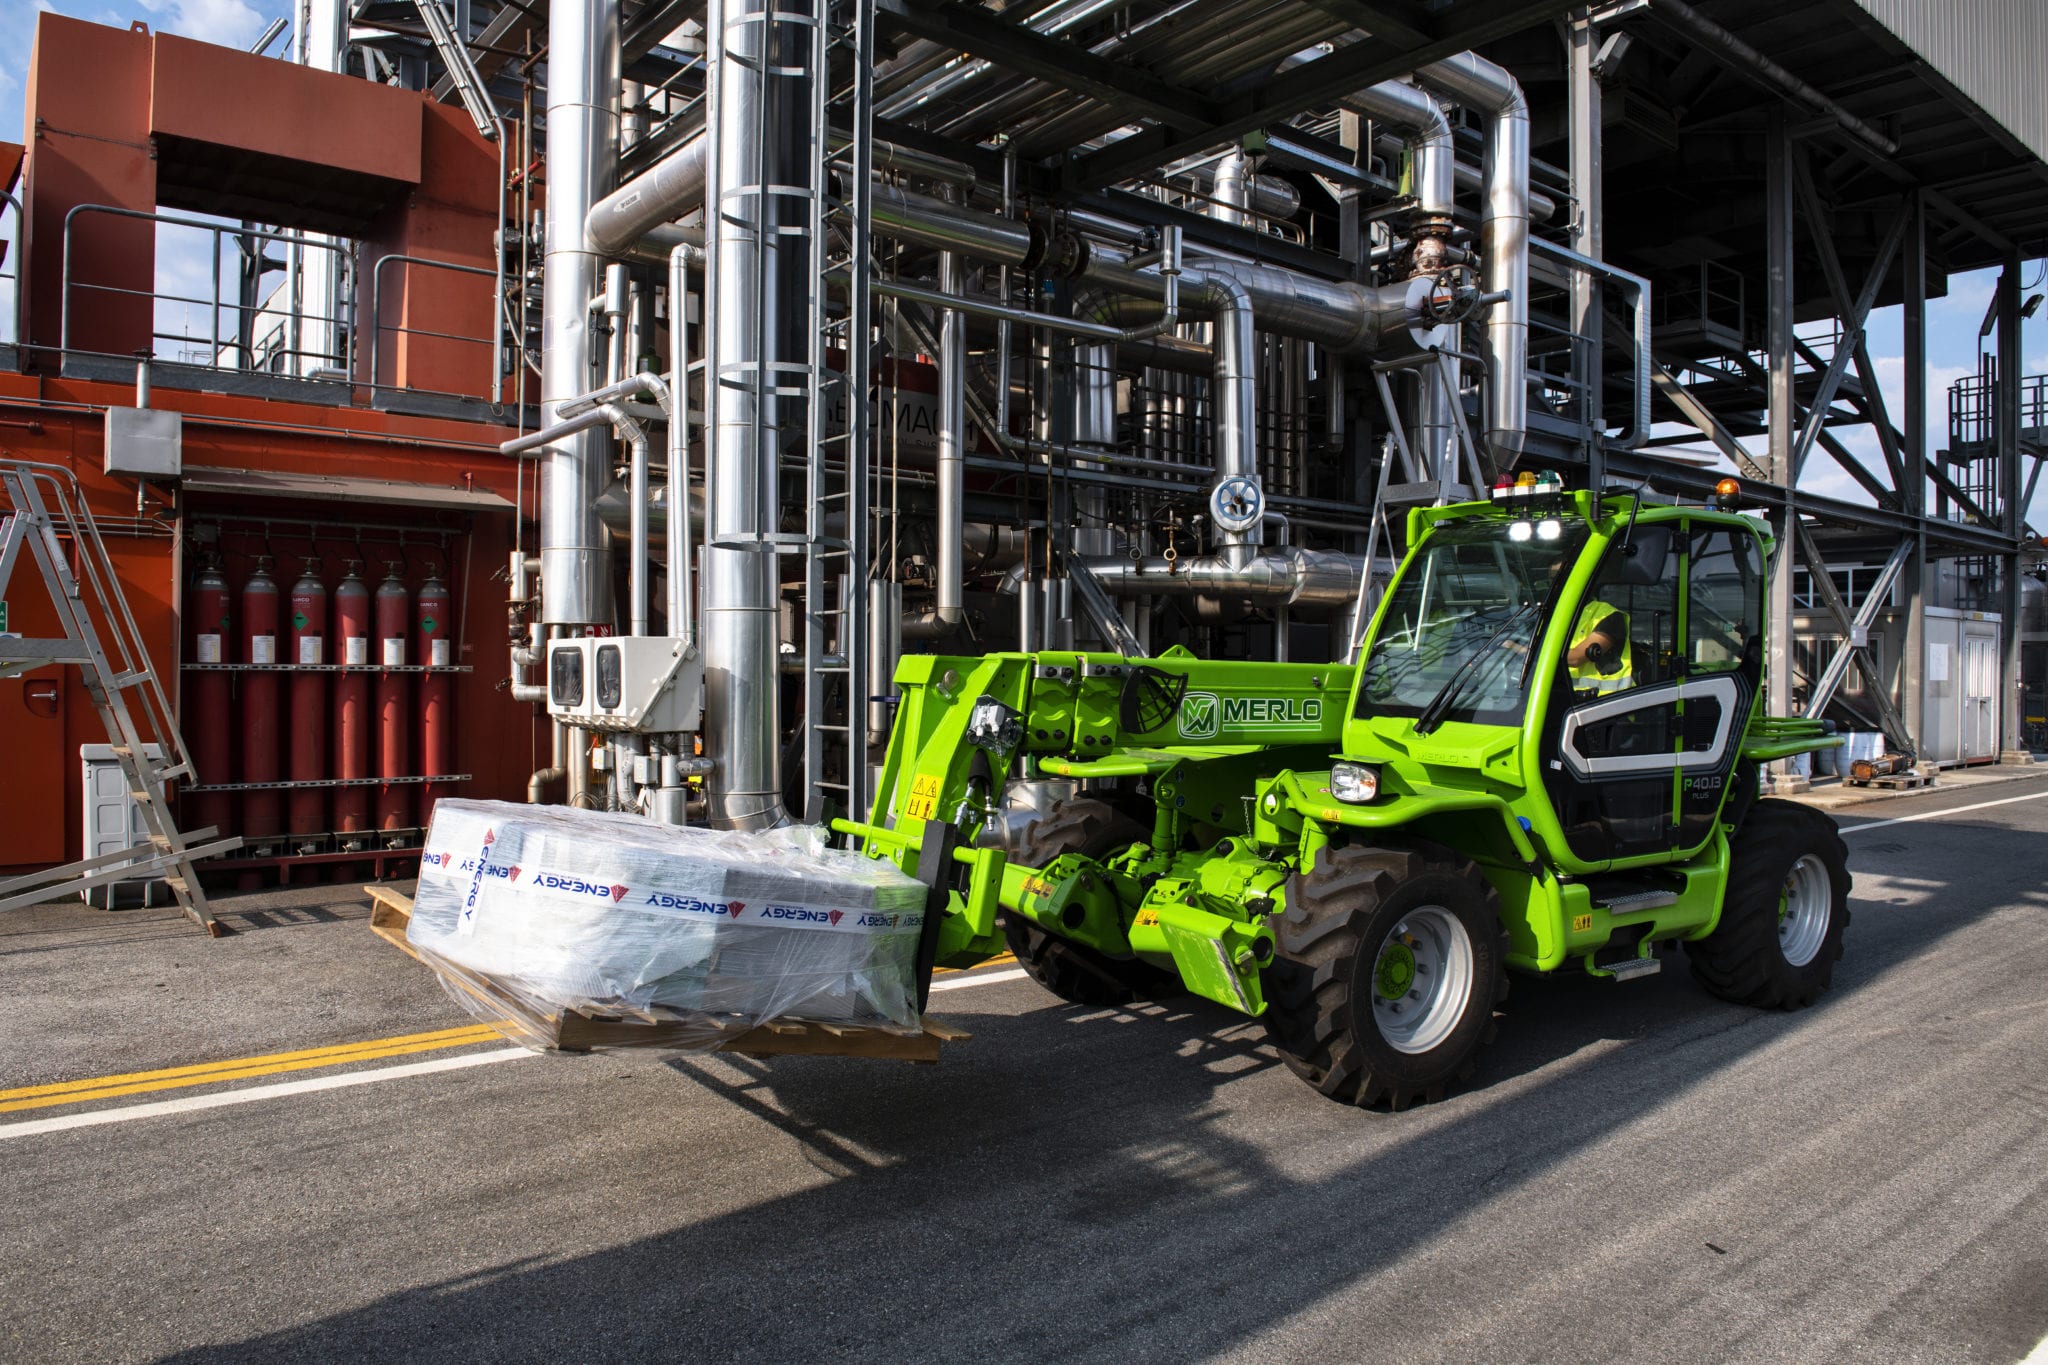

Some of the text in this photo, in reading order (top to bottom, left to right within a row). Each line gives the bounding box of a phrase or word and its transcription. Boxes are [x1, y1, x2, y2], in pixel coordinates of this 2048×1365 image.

[1223, 697, 1322, 723] MERLO
[1684, 776, 1721, 791] P40.13
[465, 845, 489, 920] ENERGY
[533, 874, 610, 897] ENERGY
[645, 892, 728, 915] ENERGY
[760, 907, 829, 923] ENERGY
